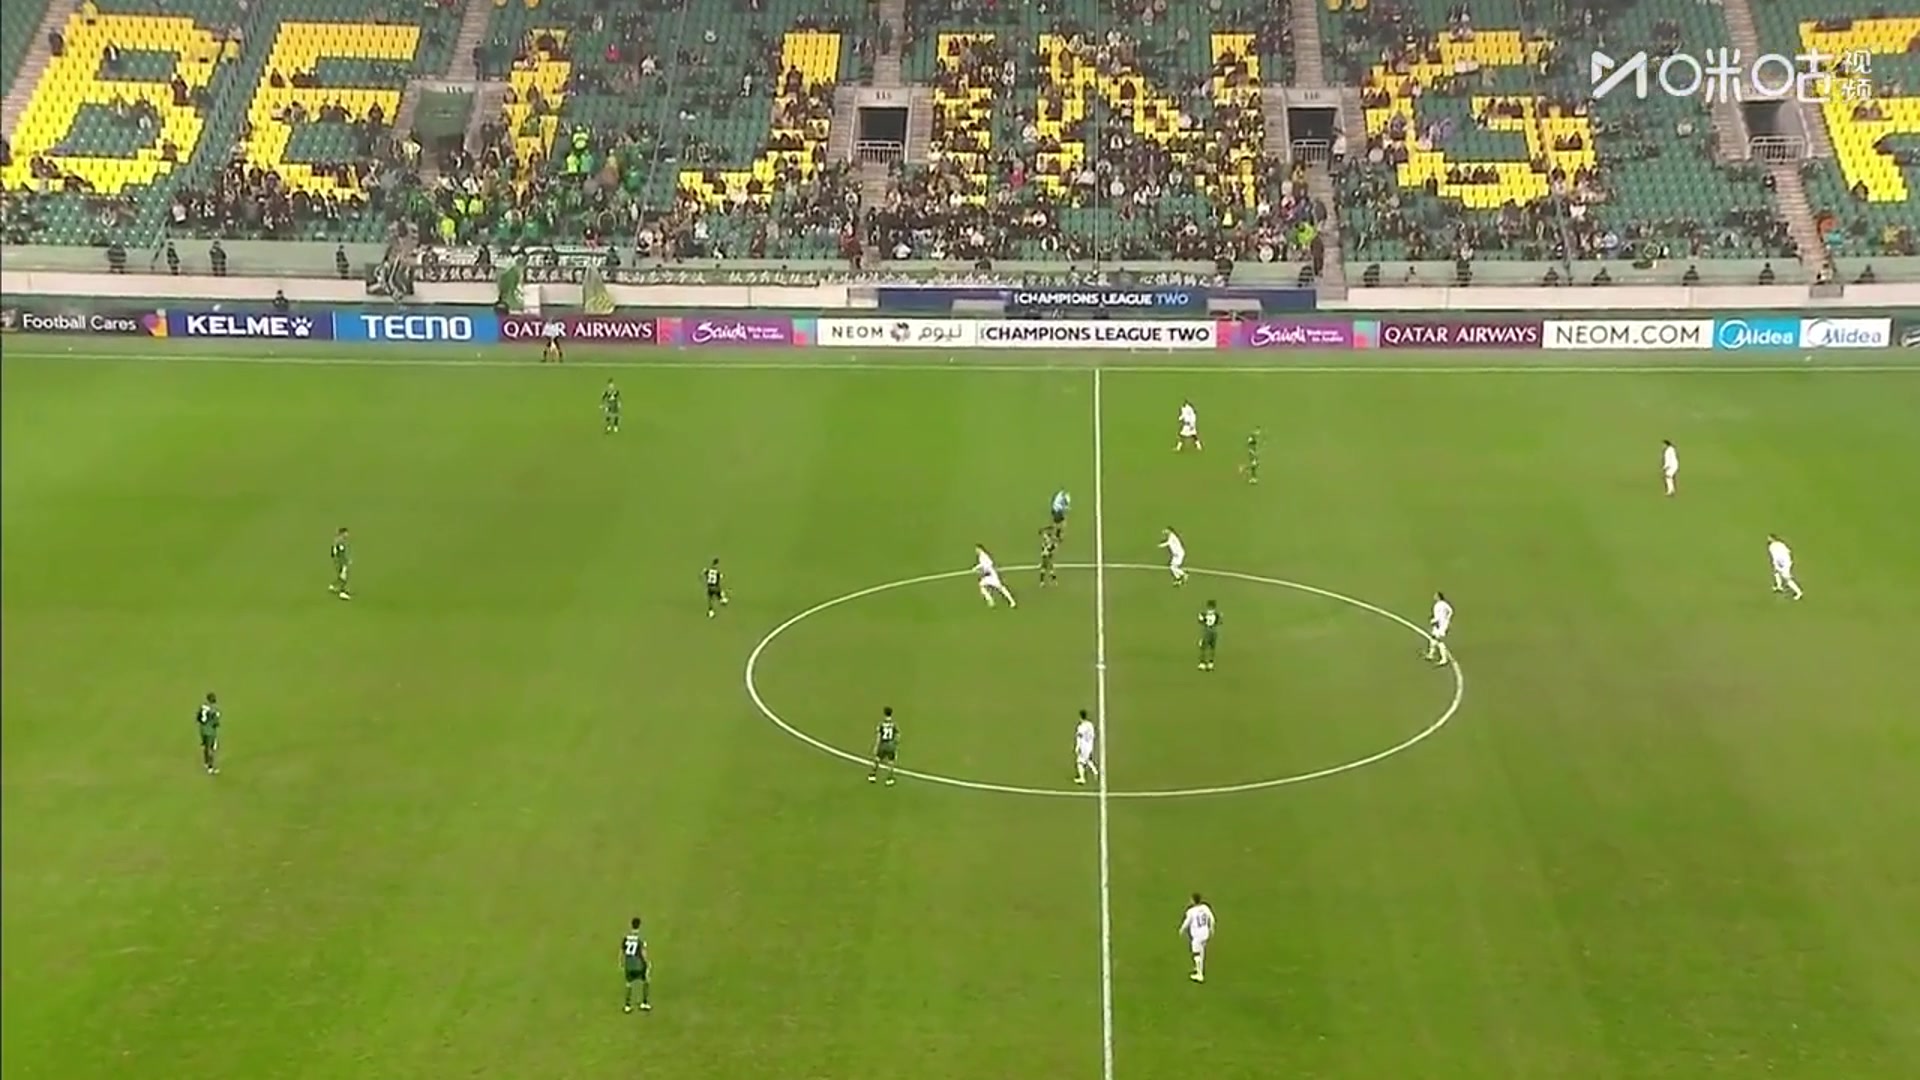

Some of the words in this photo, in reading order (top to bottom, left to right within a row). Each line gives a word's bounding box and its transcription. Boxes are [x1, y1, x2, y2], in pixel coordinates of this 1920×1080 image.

[1020, 292, 1099, 305] CHAMPIONS
[1102, 293, 1152, 305] LEAGUE
[1157, 292, 1188, 305] TWO
[23, 314, 86, 329] Football
[90, 316, 136, 331] Cares
[187, 315, 289, 336] KELME
[361, 315, 472, 340] TECNO
[574, 322, 652, 338] AIRWAYS
[832, 327, 882, 338] NEOM
[986, 327, 1090, 341] CHAMPIONS
[1095, 327, 1161, 341] LEAGUE
[1167, 327, 1209, 341] TWO
[1384, 327, 1448, 344] QATAR
[1456, 327, 1537, 342] AIRWAYS
[1556, 326, 1700, 344] NEOM.COM
[1733, 326, 1793, 345] Midea
[1821, 326, 1882, 343] Midea
[882, 728, 893, 739] 21
[625, 941, 638, 955] 27
